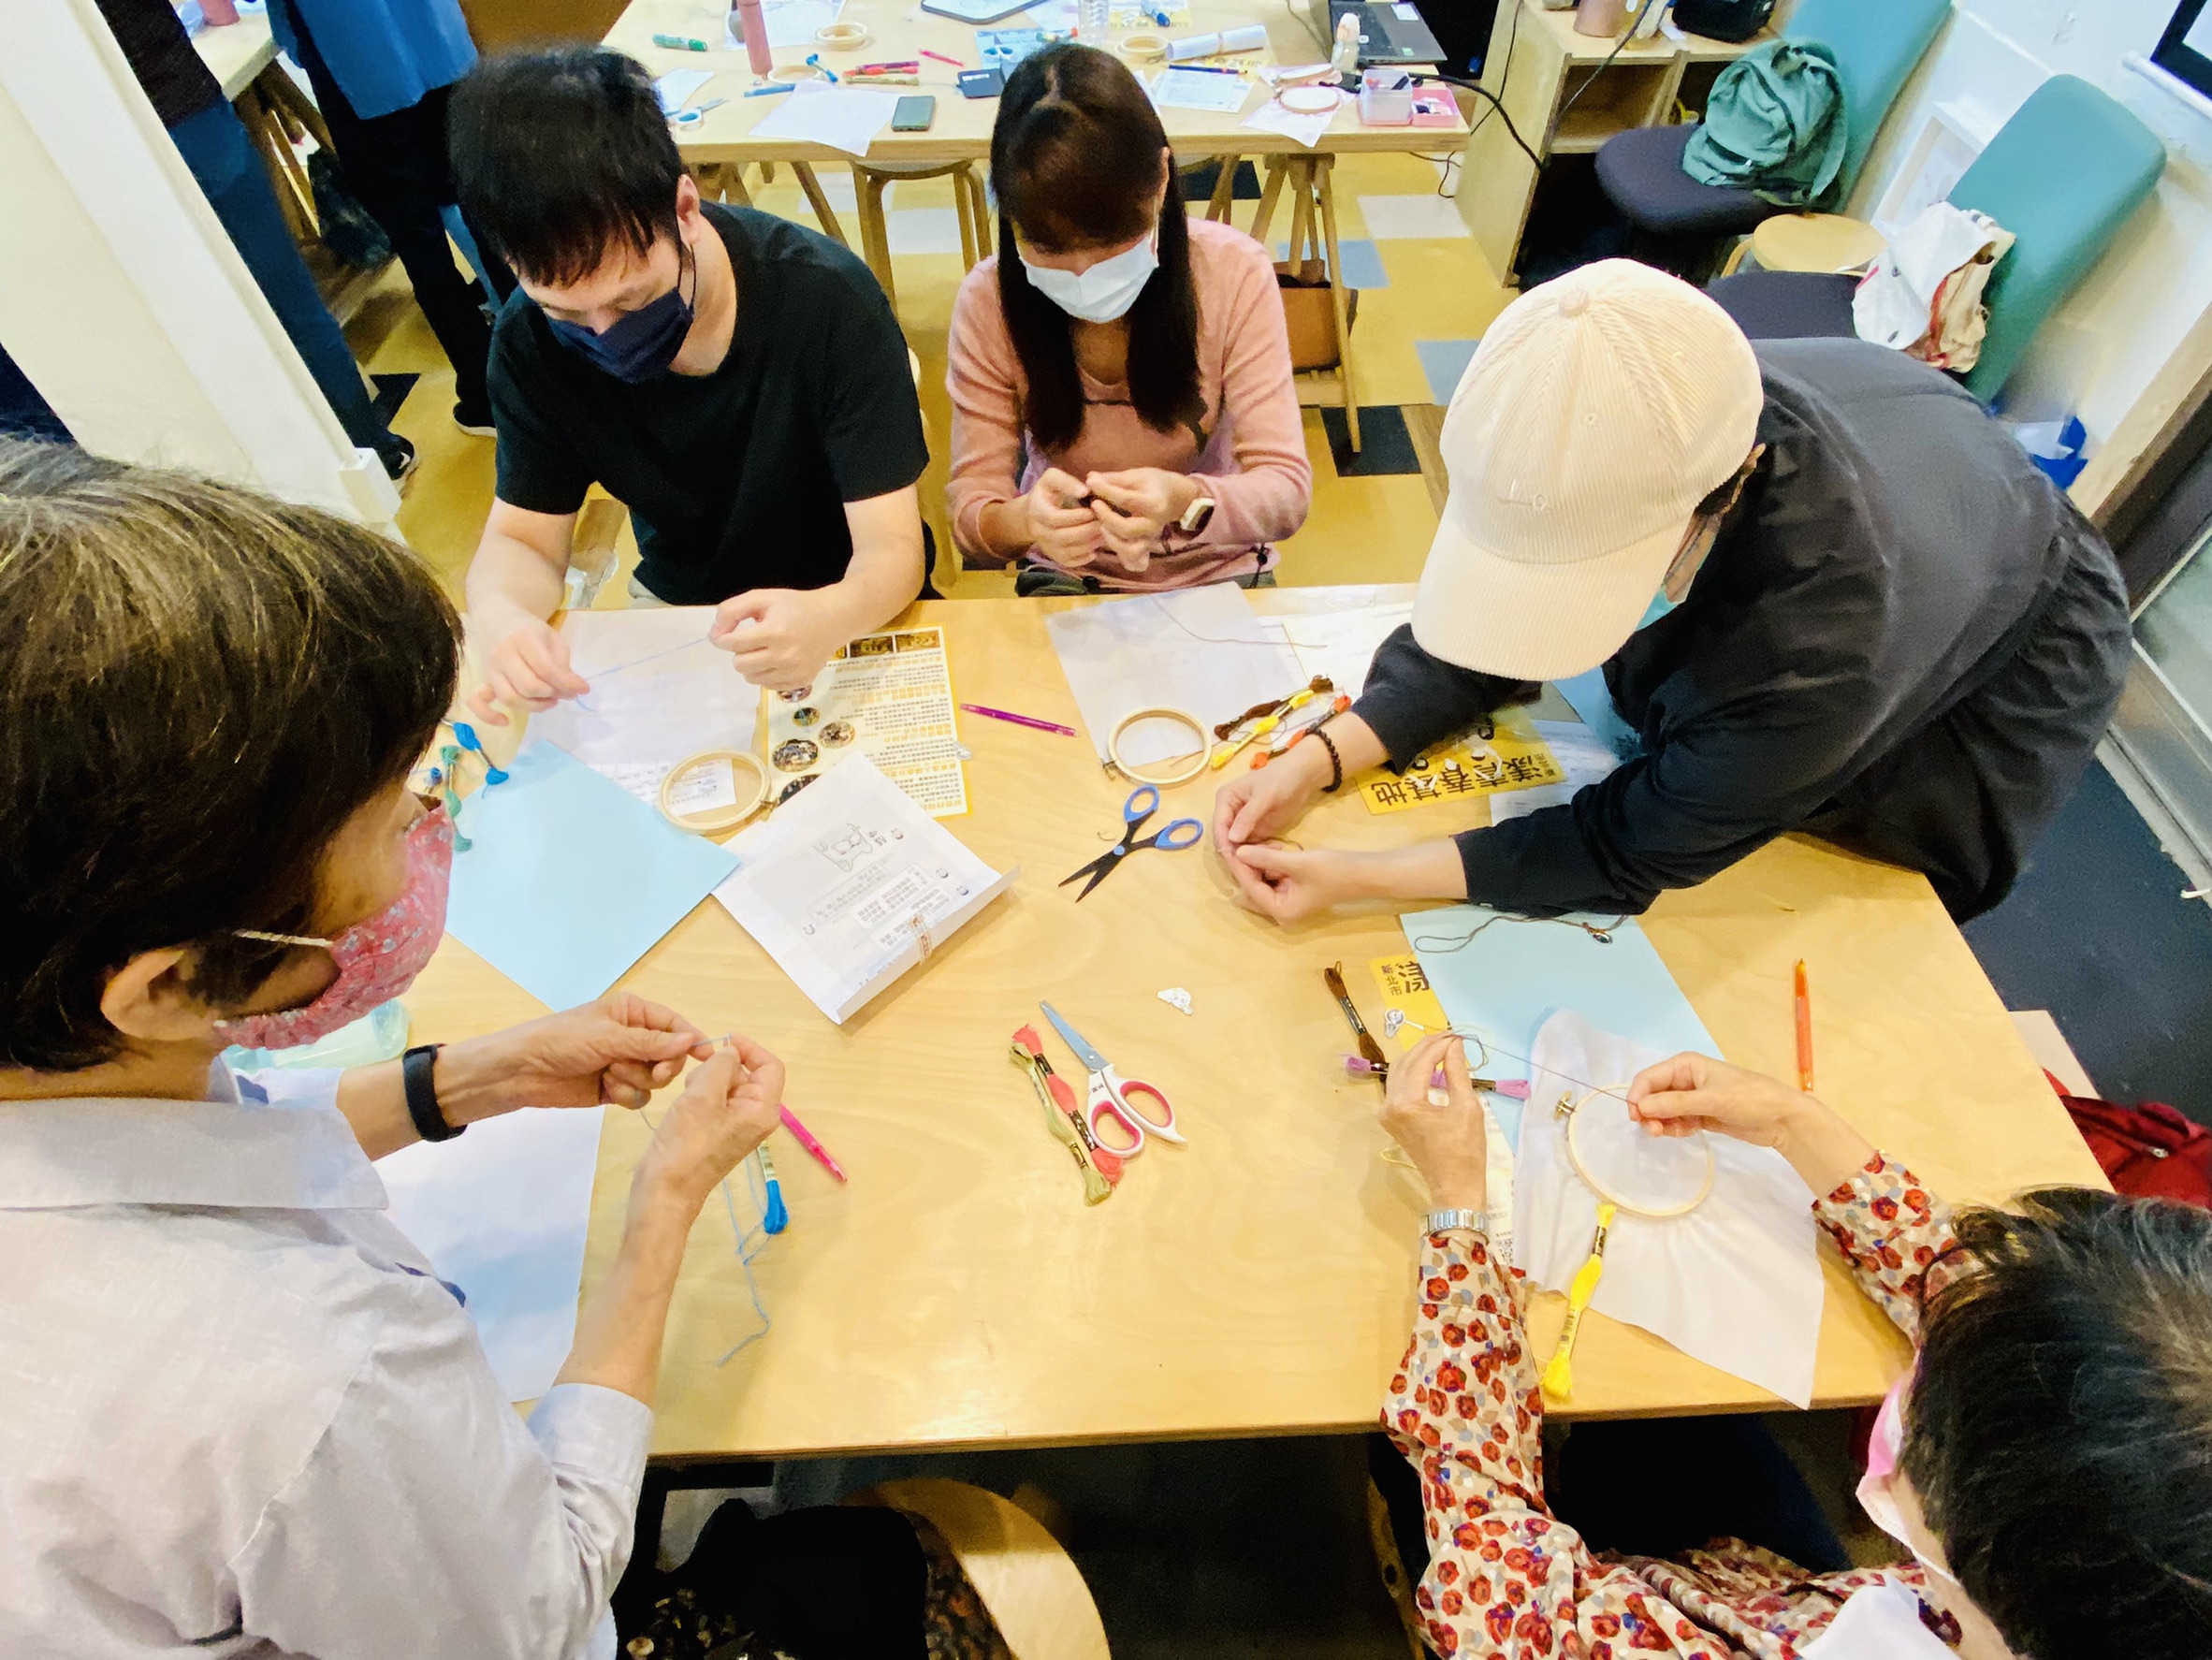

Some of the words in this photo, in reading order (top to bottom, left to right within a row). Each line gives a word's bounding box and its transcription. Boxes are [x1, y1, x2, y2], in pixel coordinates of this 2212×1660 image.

[1371, 755, 1543, 806] 漾青春基地
[1381, 964, 1403, 997] 新北市
